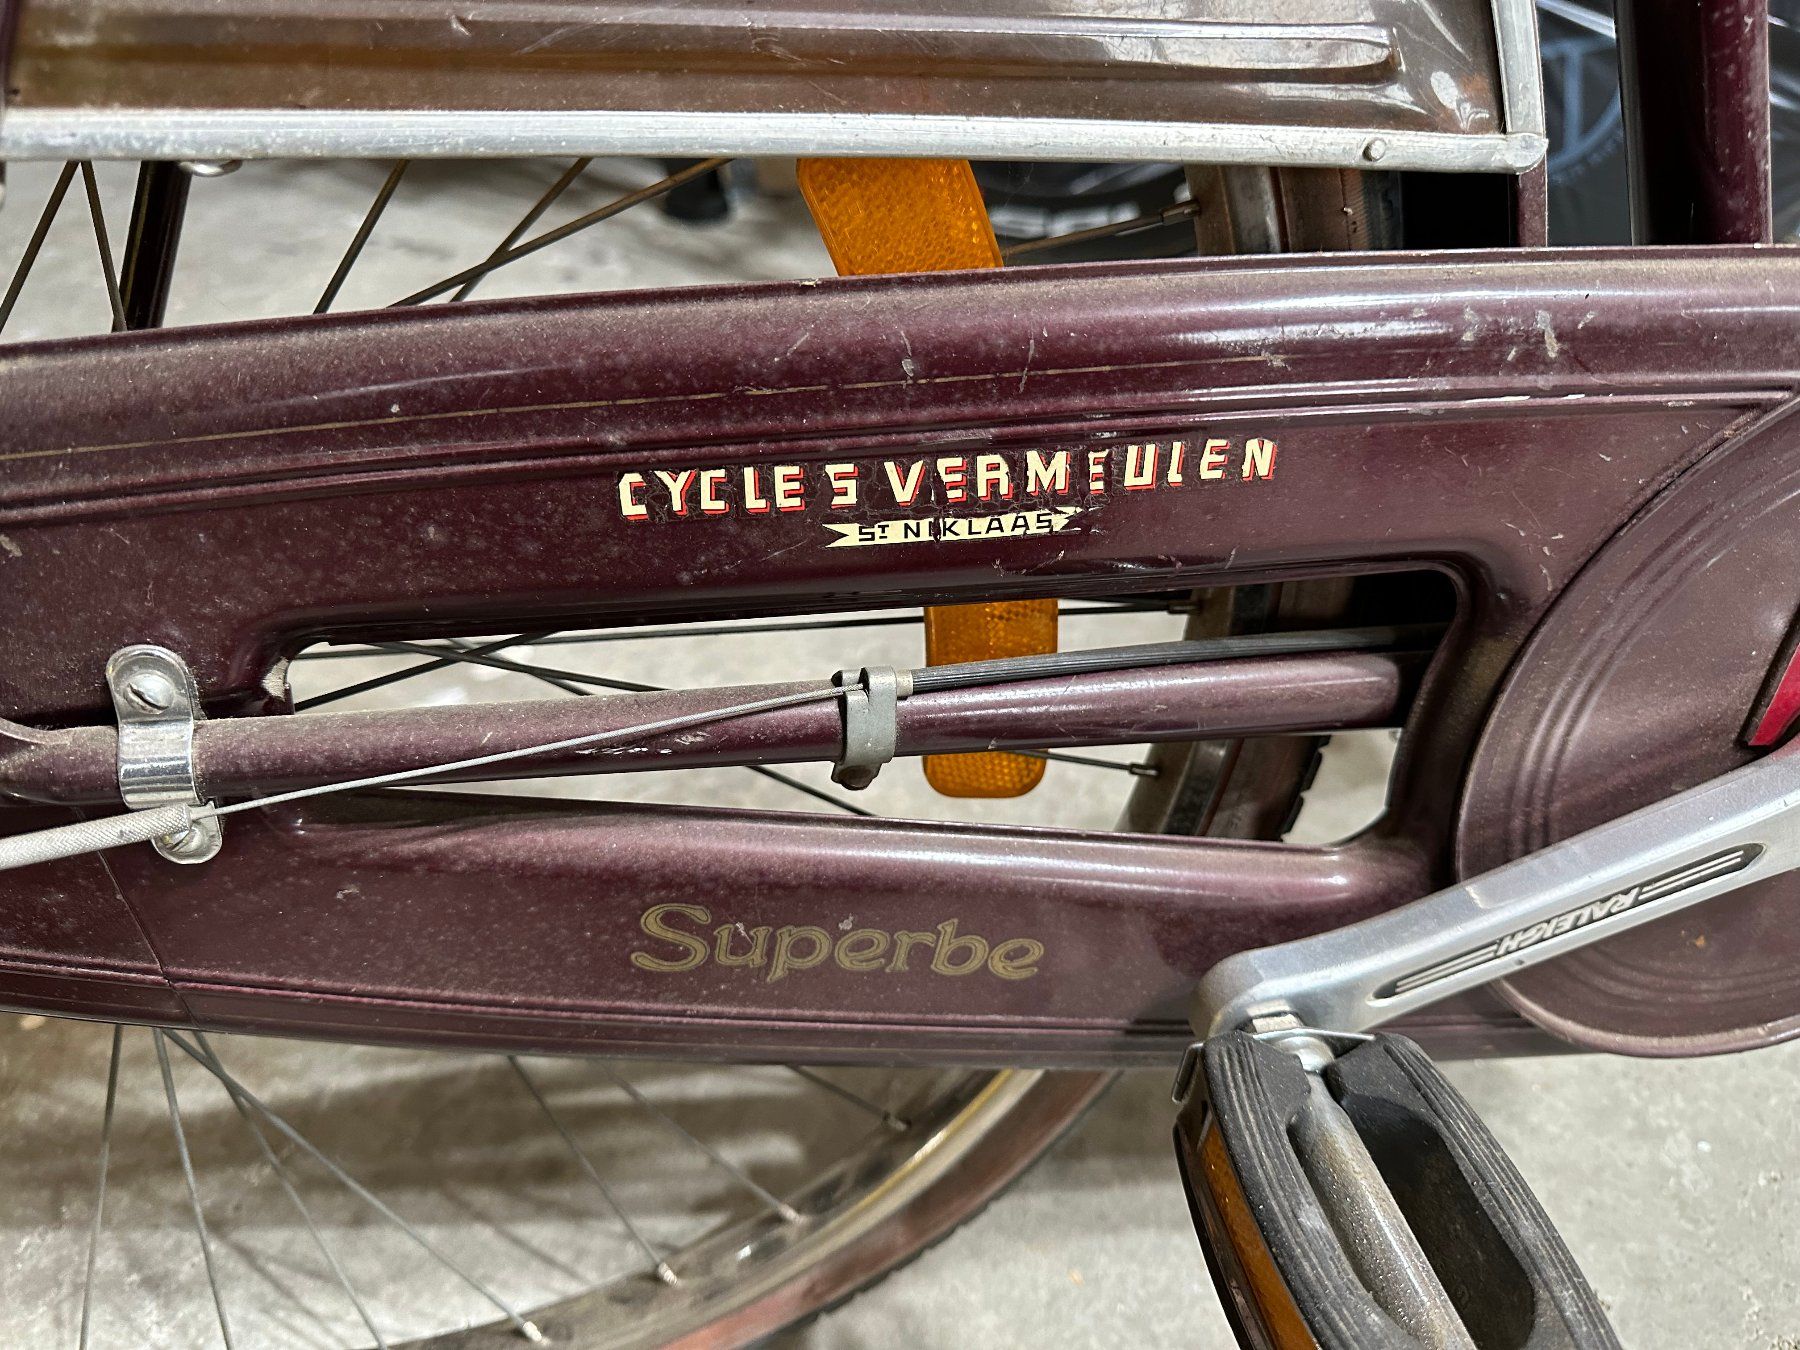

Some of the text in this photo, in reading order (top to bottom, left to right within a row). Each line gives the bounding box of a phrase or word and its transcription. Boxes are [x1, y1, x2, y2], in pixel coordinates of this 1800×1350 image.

[618, 438, 1278, 521] CYCLES VERMEULEN
[903, 512, 1054, 539] NIKLAAS
[630, 902, 1045, 984] Superbe
[1497, 885, 1642, 957] RALEIGH
